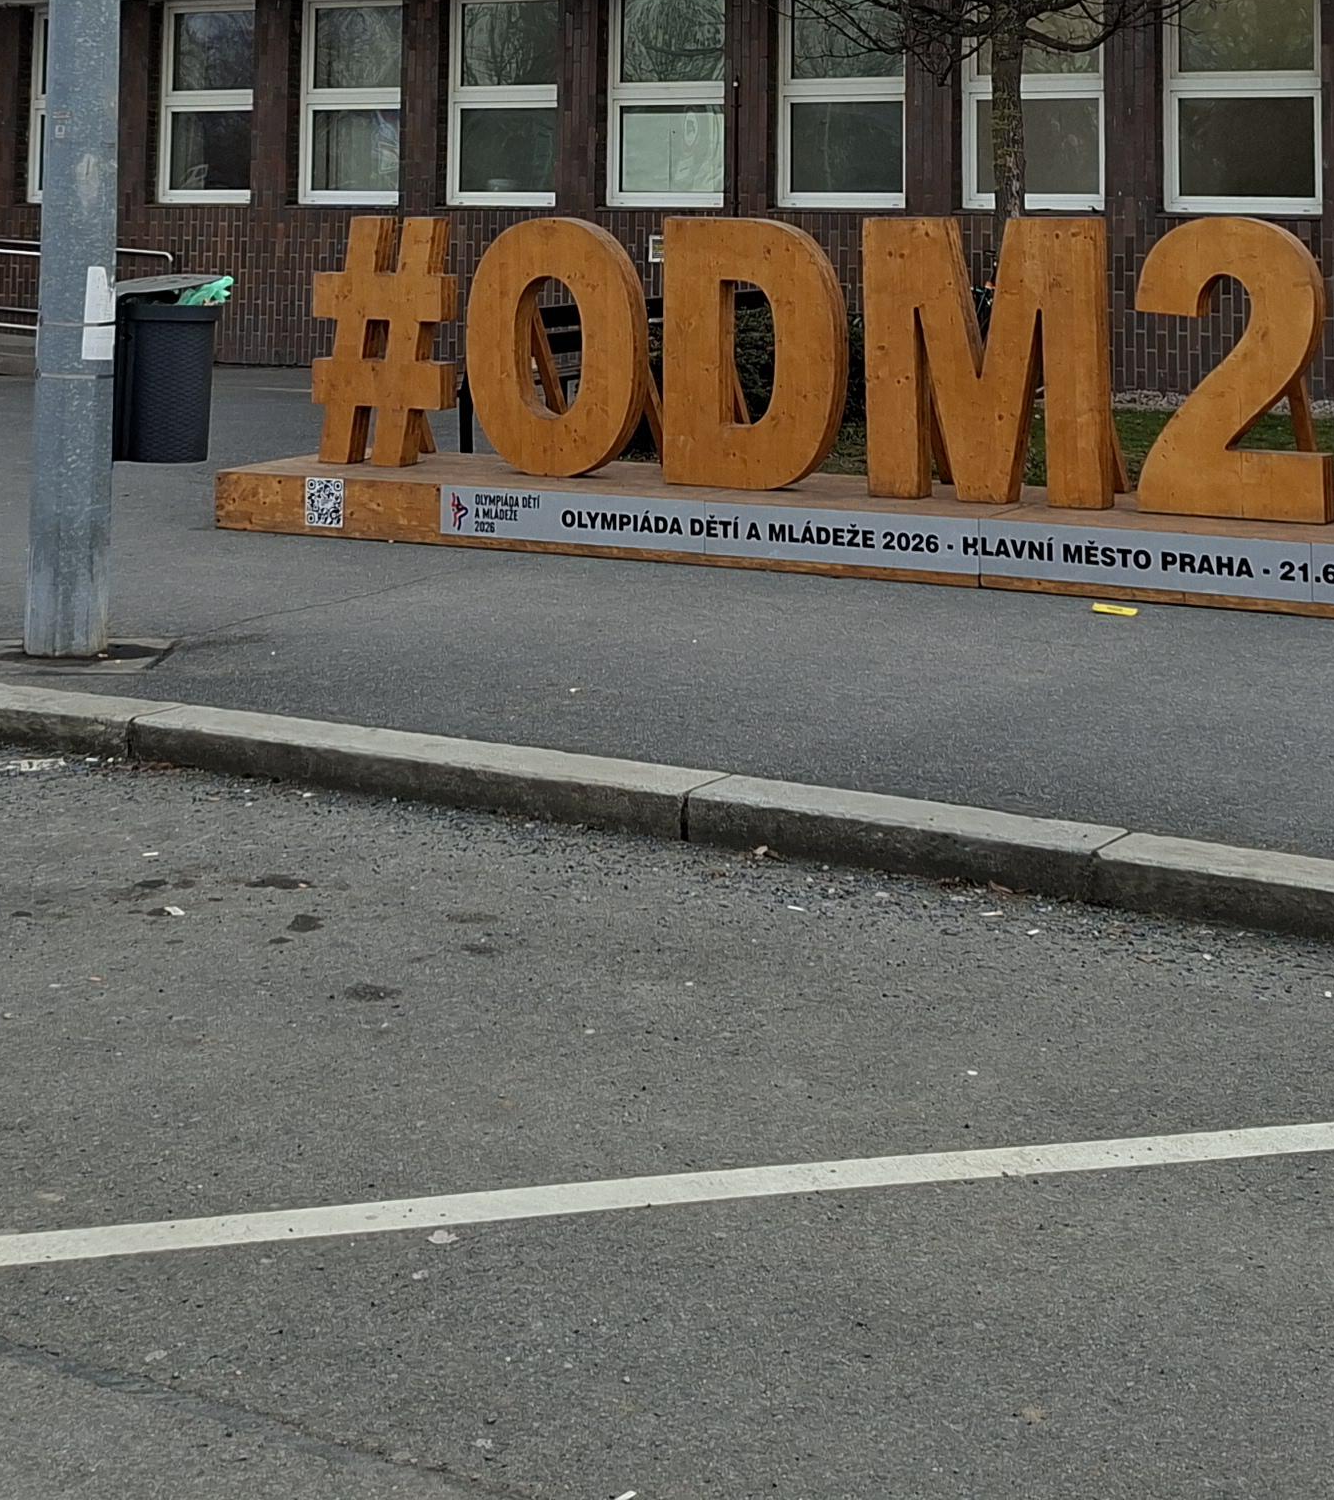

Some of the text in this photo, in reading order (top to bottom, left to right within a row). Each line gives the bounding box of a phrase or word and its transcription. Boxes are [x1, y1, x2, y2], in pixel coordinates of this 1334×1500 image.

[474, 491, 541, 509] OLYMPIÁDA DĚTÍ
[474, 507, 519, 523] A MLÁDEŽE
[474, 521, 495, 534] 2026
[561, 509, 683, 536] OLYMPIÁDA
[690, 515, 740, 540] DĚTÍ
[746, 521, 762, 541] A
[768, 519, 876, 550] MLÁDEŽE
[882, 531, 940, 554] 2026
[962, 535, 1054, 563] HLAVNÍ
[1063, 540, 1153, 571] MĚSTO
[1161, 550, 1255, 579] PRAHA
